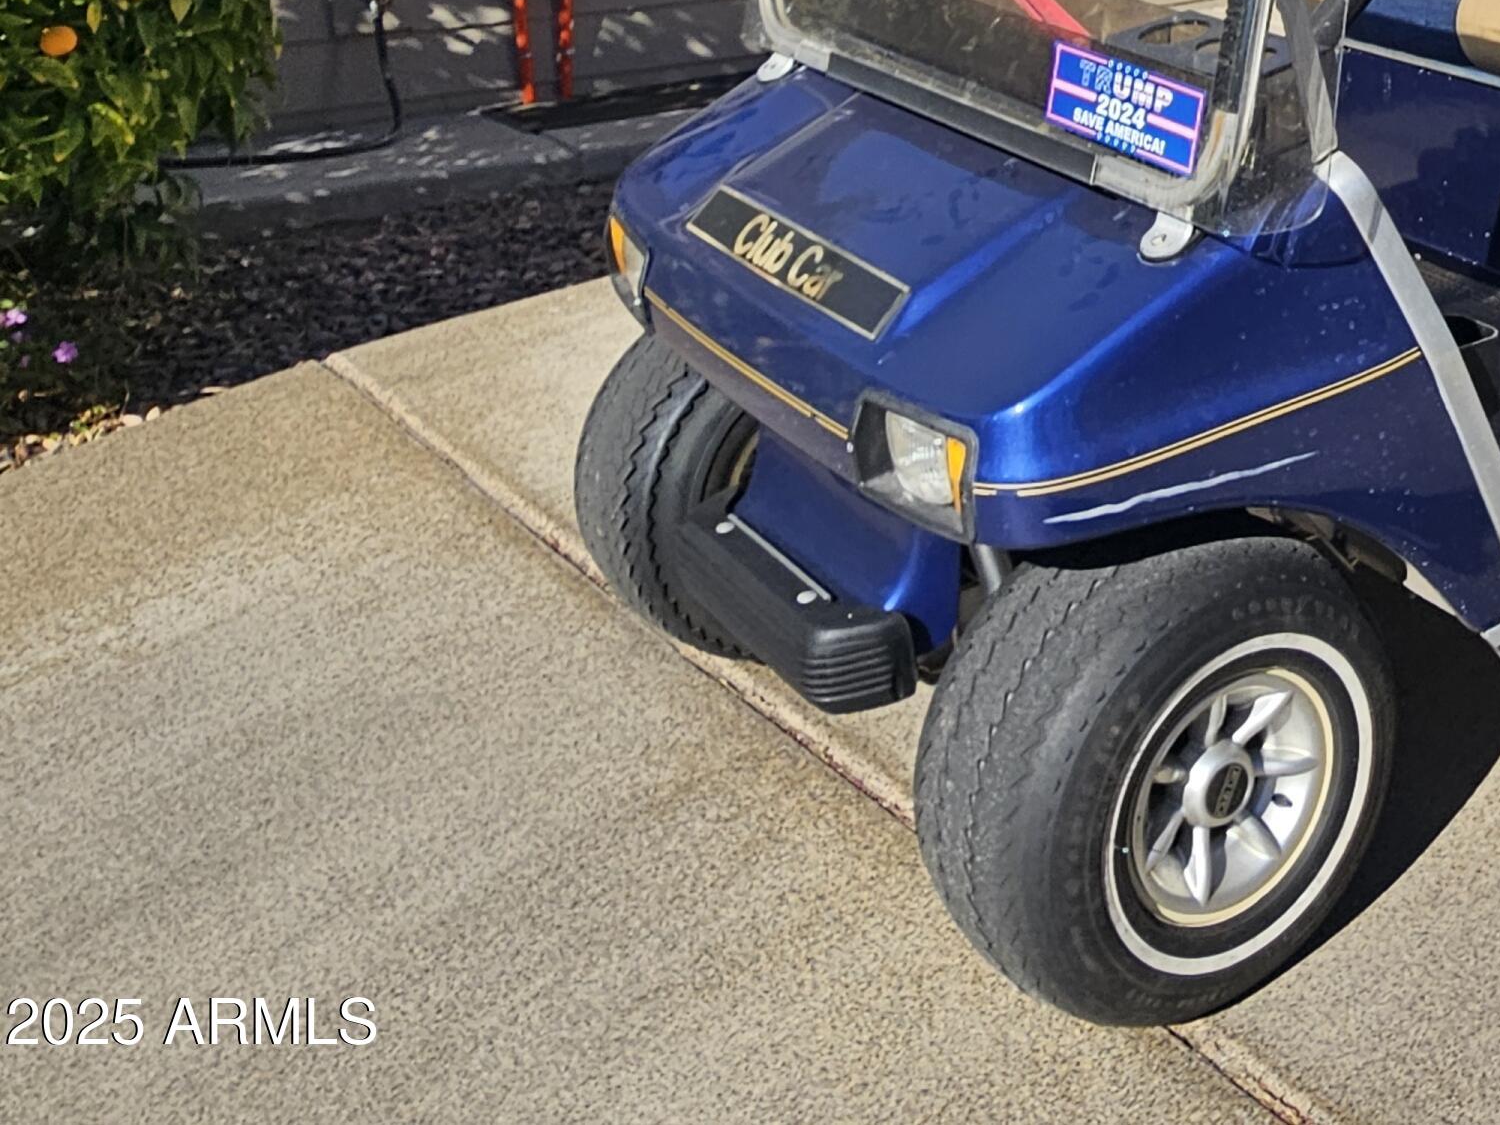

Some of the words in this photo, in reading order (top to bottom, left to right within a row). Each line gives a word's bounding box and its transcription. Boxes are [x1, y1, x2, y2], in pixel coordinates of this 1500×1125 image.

[1079, 59, 1173, 113] TRUMP
[1096, 94, 1146, 130] 2024
[1073, 106, 1105, 131] SAVE
[1105, 120, 1166, 156] AMERICA!
[734, 214, 795, 275] Club
[787, 245, 844, 301] Car
